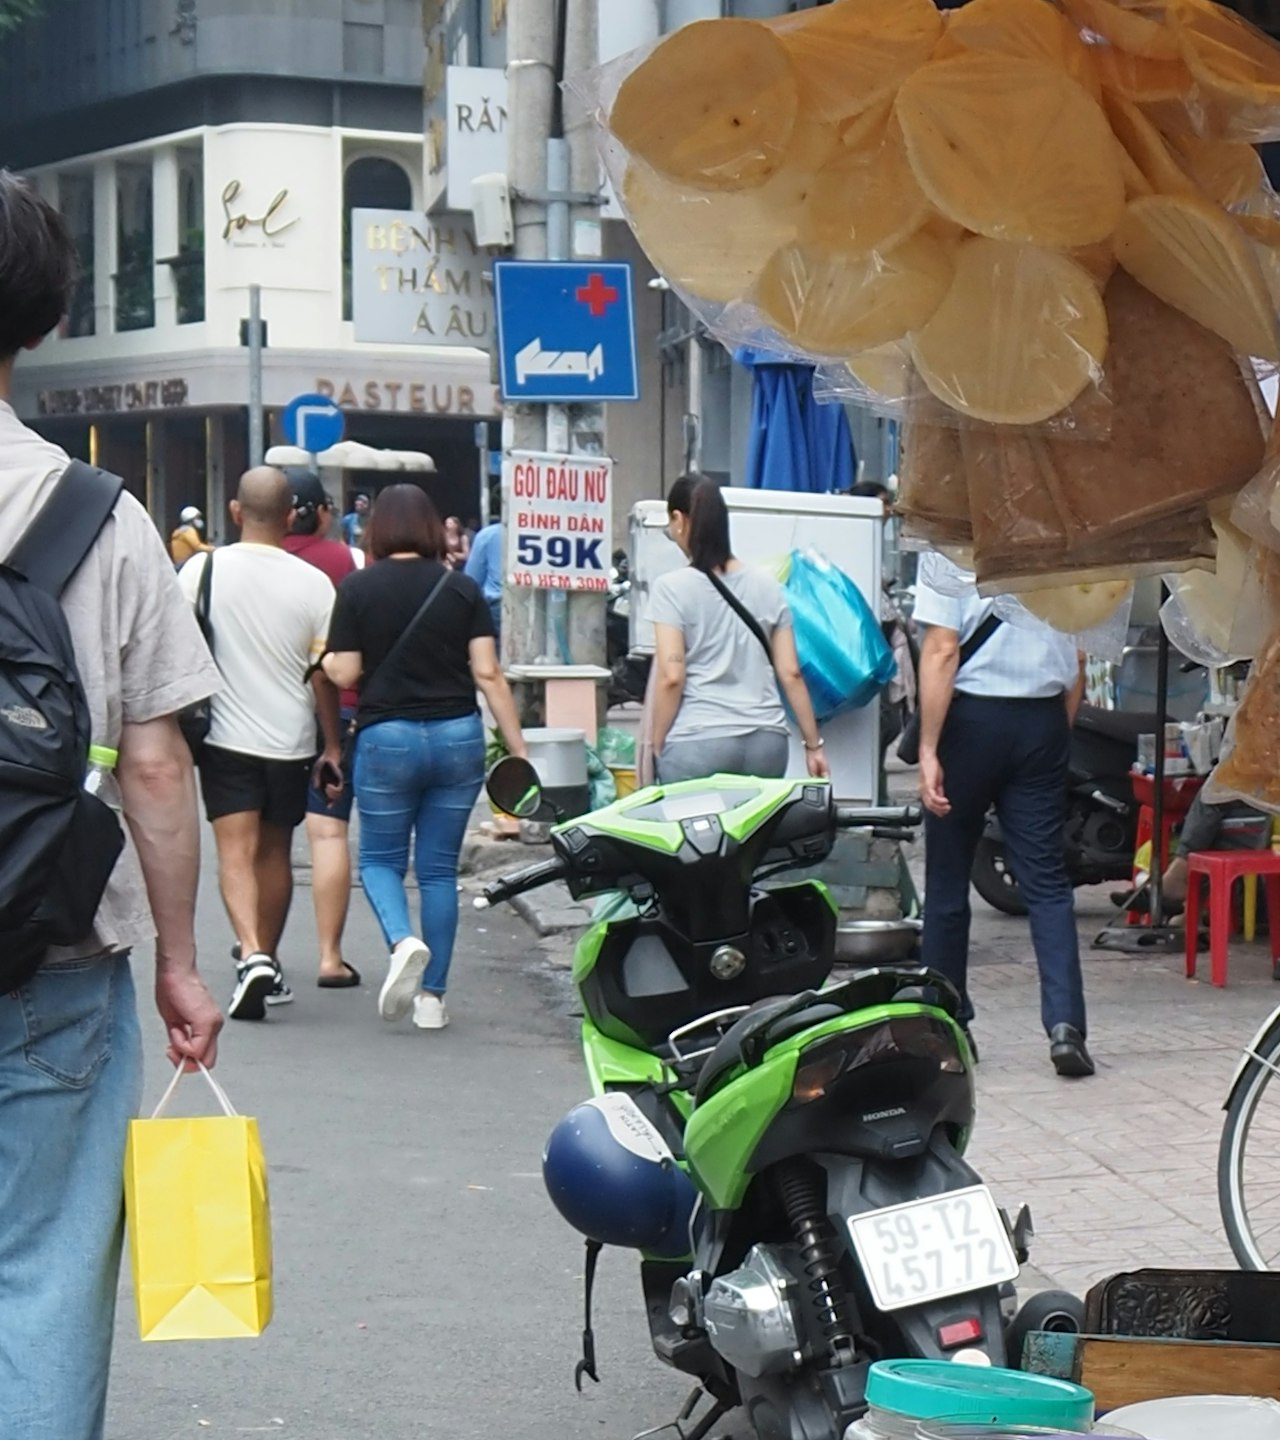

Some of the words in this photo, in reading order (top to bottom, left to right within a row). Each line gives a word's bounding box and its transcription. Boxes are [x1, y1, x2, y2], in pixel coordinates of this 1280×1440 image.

[445, 305, 487, 337] ÂU
[316, 377, 475, 414] PASTEUR
[514, 458, 540, 506] GỘI
[567, 513, 604, 533] DÂN
[517, 534, 604, 570] 59K
[862, 1106, 907, 1122] HONDA
[873, 1198, 981, 1255] 59-T2
[882, 1237, 1006, 1299] 457.72
